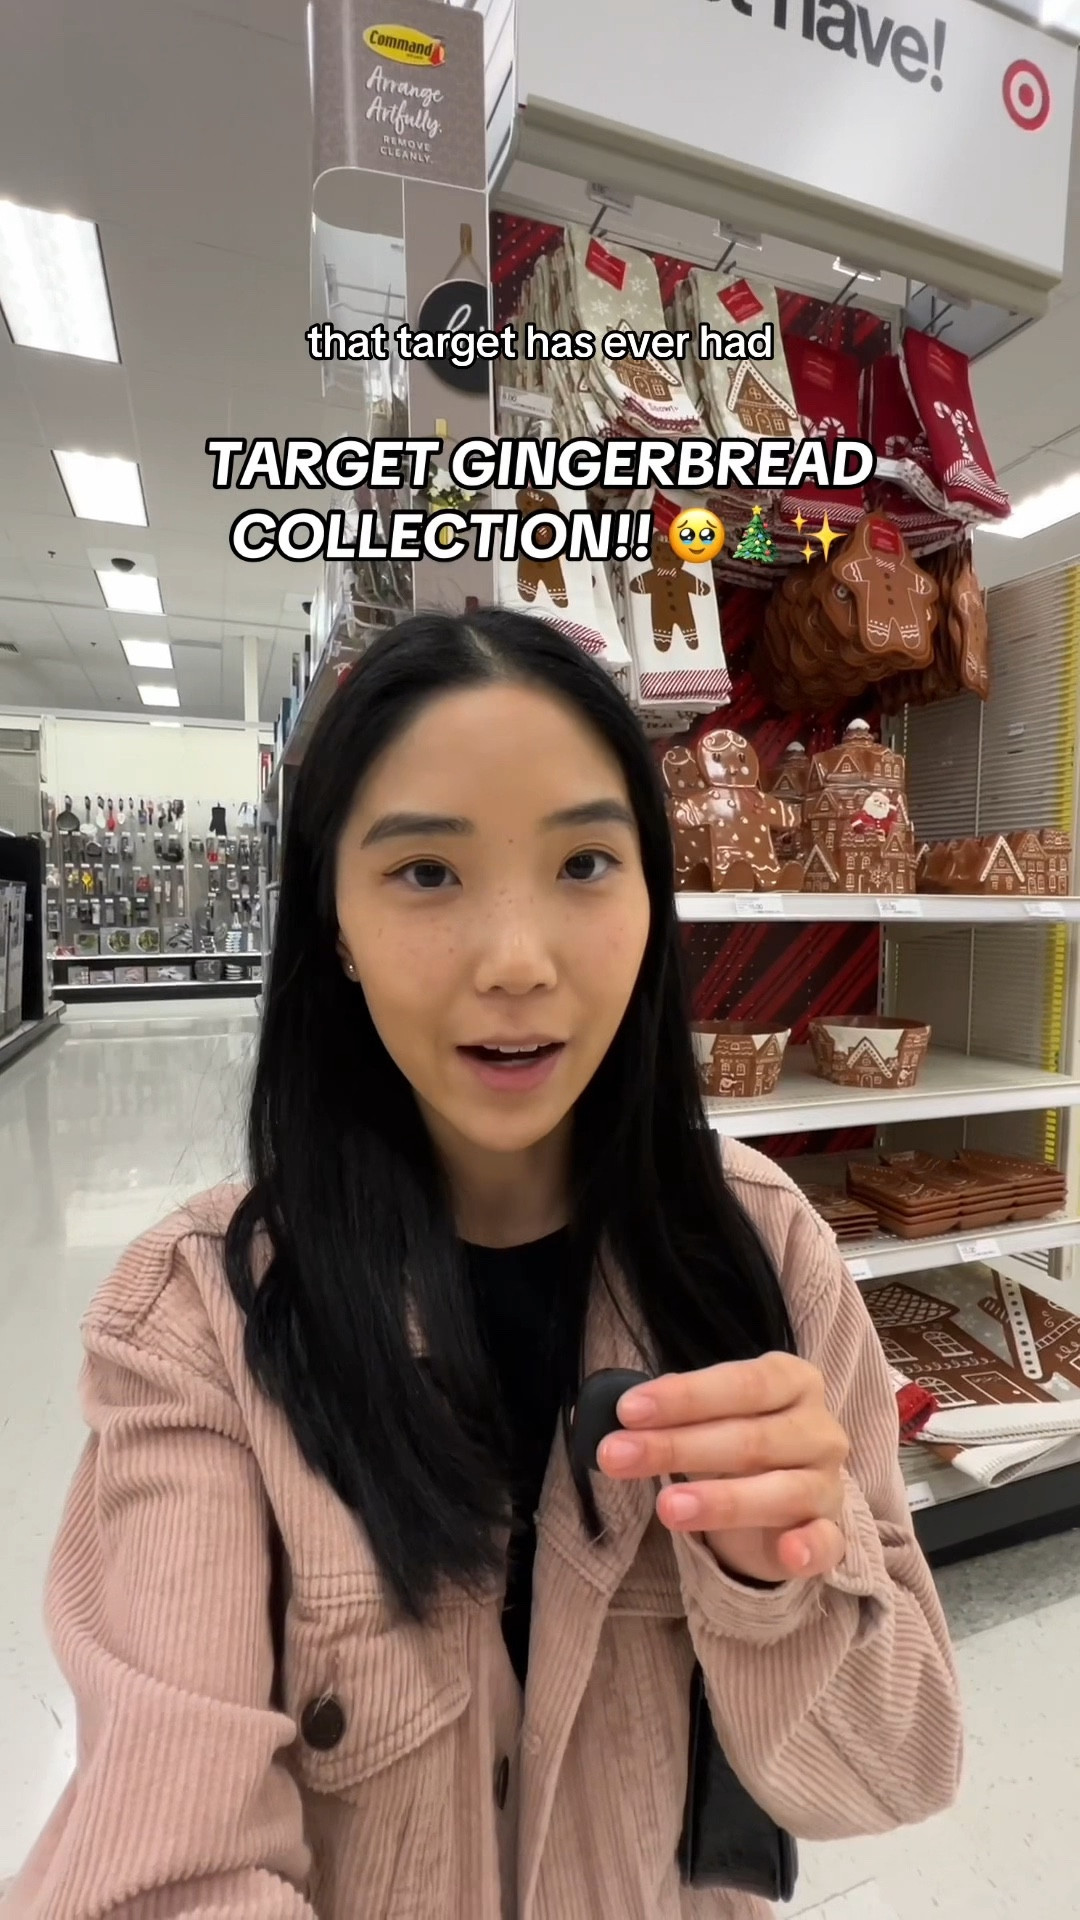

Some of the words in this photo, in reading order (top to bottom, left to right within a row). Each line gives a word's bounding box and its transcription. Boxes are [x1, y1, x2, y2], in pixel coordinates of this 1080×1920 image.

[369, 29, 434, 57] Command
[366, 65, 443, 107] Arrange
[366, 95, 443, 139] Artfully.
[380, 146, 434, 164] CLEANLY.
[383, 135, 431, 152] REMOVE
